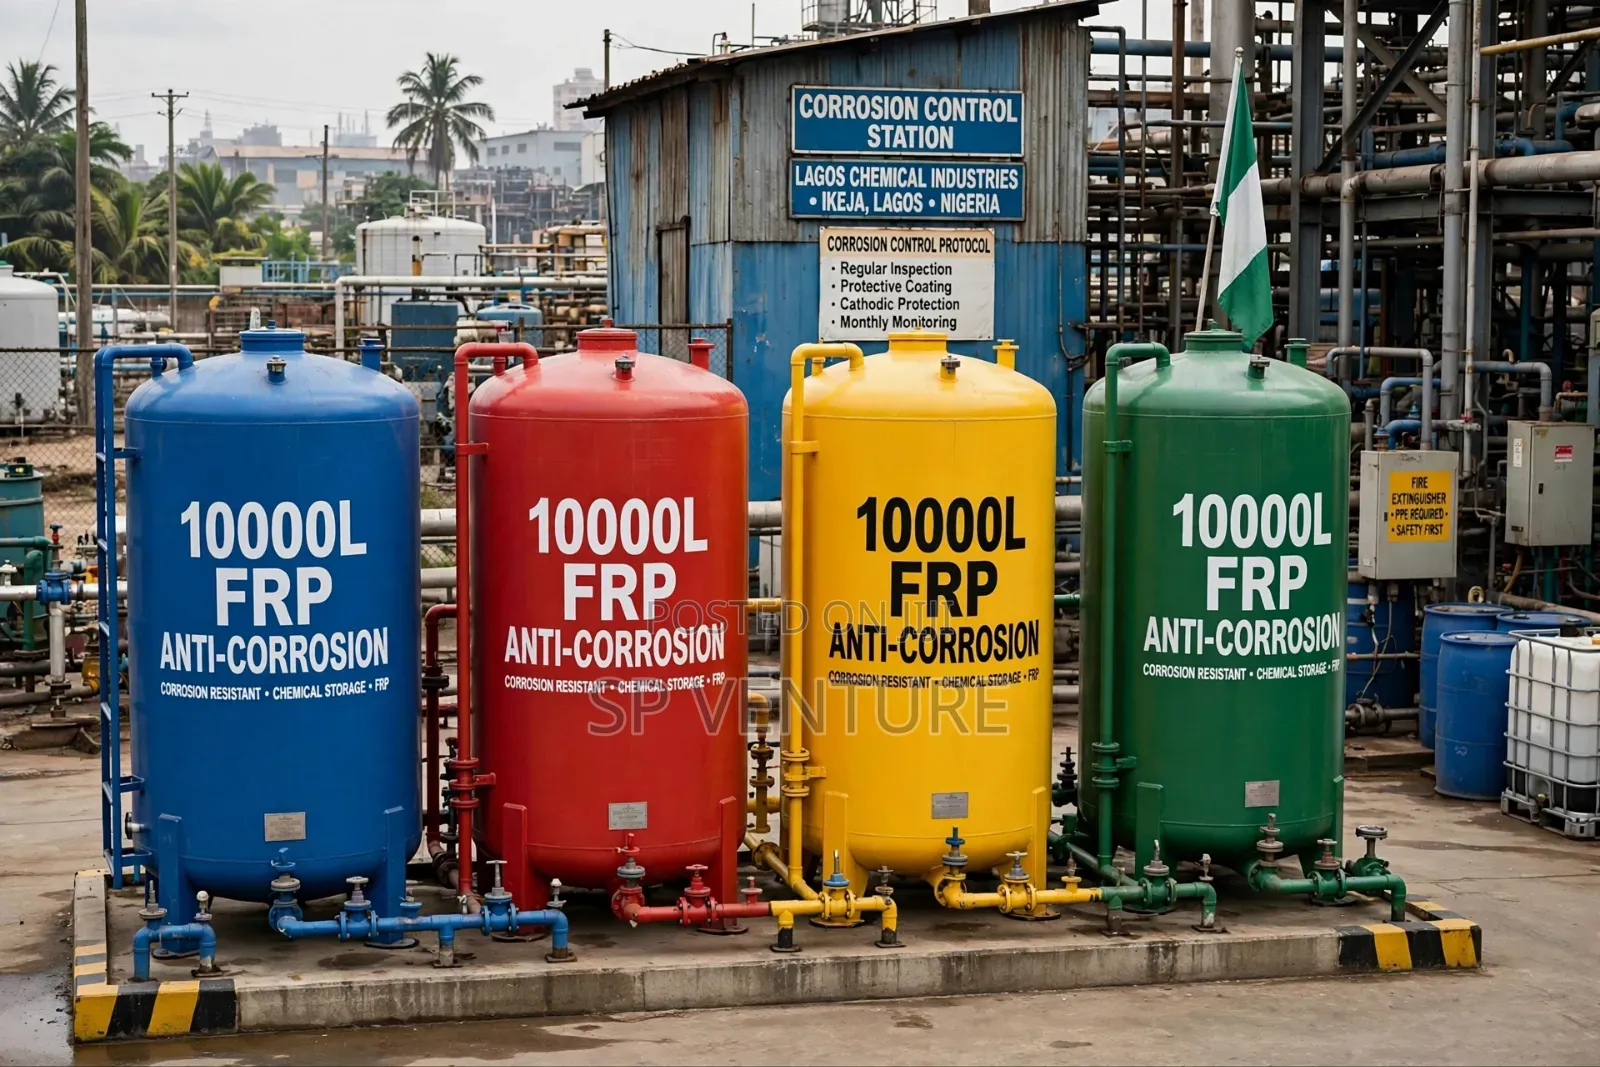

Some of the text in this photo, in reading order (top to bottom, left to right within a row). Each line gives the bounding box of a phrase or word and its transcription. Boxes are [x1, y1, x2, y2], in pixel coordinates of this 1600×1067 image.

[799, 94, 1018, 123] CORROSION CONTROL
[867, 124, 953, 149] STATION
[795, 165, 1018, 189] LAGOS CHEMICAL INDUSTRIES
[822, 191, 1000, 215] IKEJA, LAGOS NIGERIA
[827, 236, 990, 253] CORROSION CONTROL PROTOCOL
[840, 262, 952, 278] Regular Inspection
[840, 280, 952, 295] Protective Coating
[840, 297, 959, 311] Cathodic Protection
[840, 315, 957, 332] Monthly Monitoring
[1411, 477, 1428, 488] FIRE
[1392, 492, 1446, 505] EXTINGUISHER
[529, 497, 708, 555] 10000L
[857, 496, 1026, 553] 10000L
[1173, 492, 1332, 548] 10000L
[1395, 508, 1444, 520] PPE REQUIRED
[181, 500, 367, 559] 10000L
[1396, 524, 1443, 536] SAFETY FIRST
[564, 562, 677, 621] FRP
[890, 561, 998, 618] FRP
[1206, 555, 1308, 611] FRP
[216, 567, 333, 626] FRP
[504, 622, 725, 668] ANTI-CORROSION
[829, 619, 1040, 664] ANTI-CORROSION
[1144, 612, 1340, 656] ANTI-CORROSION
[160, 627, 389, 674] ANTI-CORROSION
[504, 672, 725, 694] CORROSION RESISTANT CHEMICAL STORAGE FRP
[828, 668, 1039, 689] CORROSION RESISTANT CHEMICAL STORAGE FRP
[1143, 663, 1195, 679] CORROSION
[1198, 667, 1246, 680] RESISTANT
[1256, 666, 1297, 680] CHEMICAL
[1298, 663, 1327, 678] STORAGE
[161, 677, 389, 701] CORROSION RESISTANT CHEMICAL STORAGE FRP
